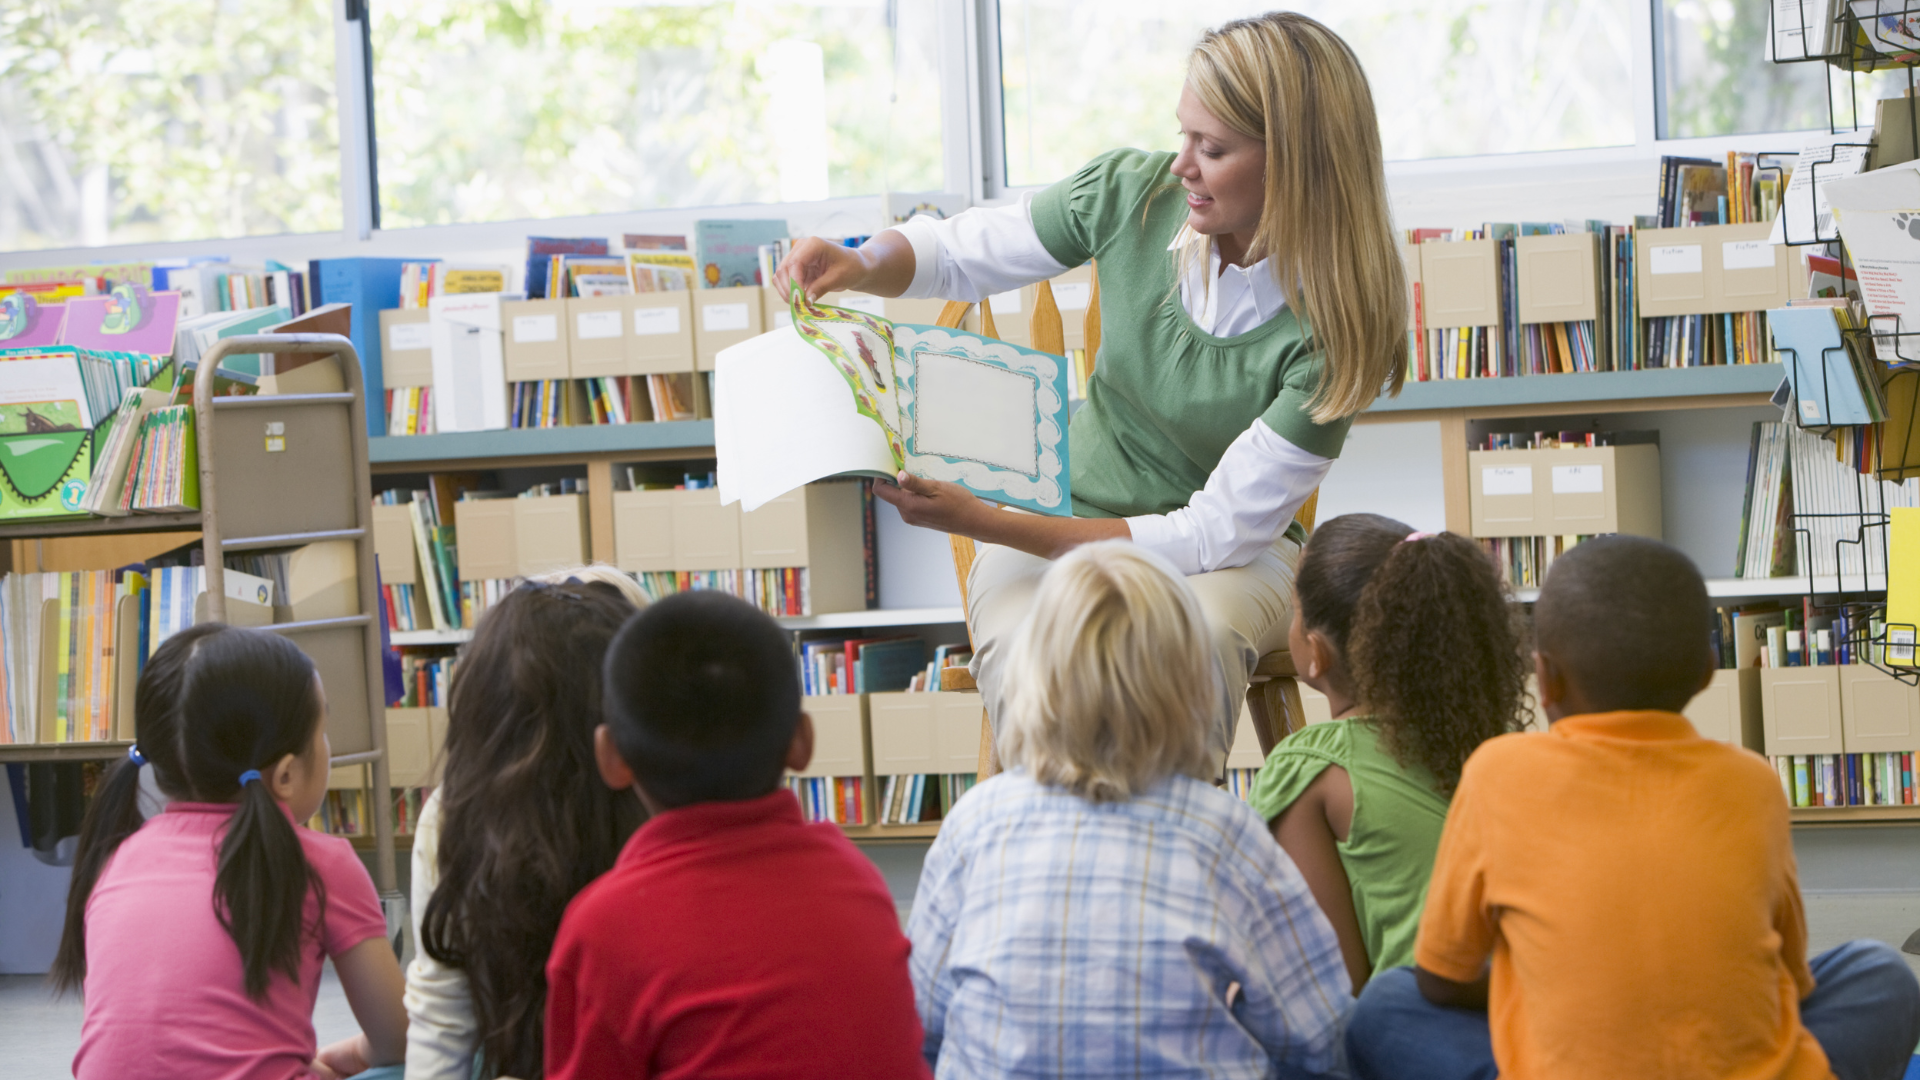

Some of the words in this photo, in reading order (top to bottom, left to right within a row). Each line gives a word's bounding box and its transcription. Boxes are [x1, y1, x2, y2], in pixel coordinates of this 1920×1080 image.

[1735, 242, 1758, 251] Fiction
[1662, 248, 1684, 256] Fiction
[1494, 468, 1515, 476] Fiction
